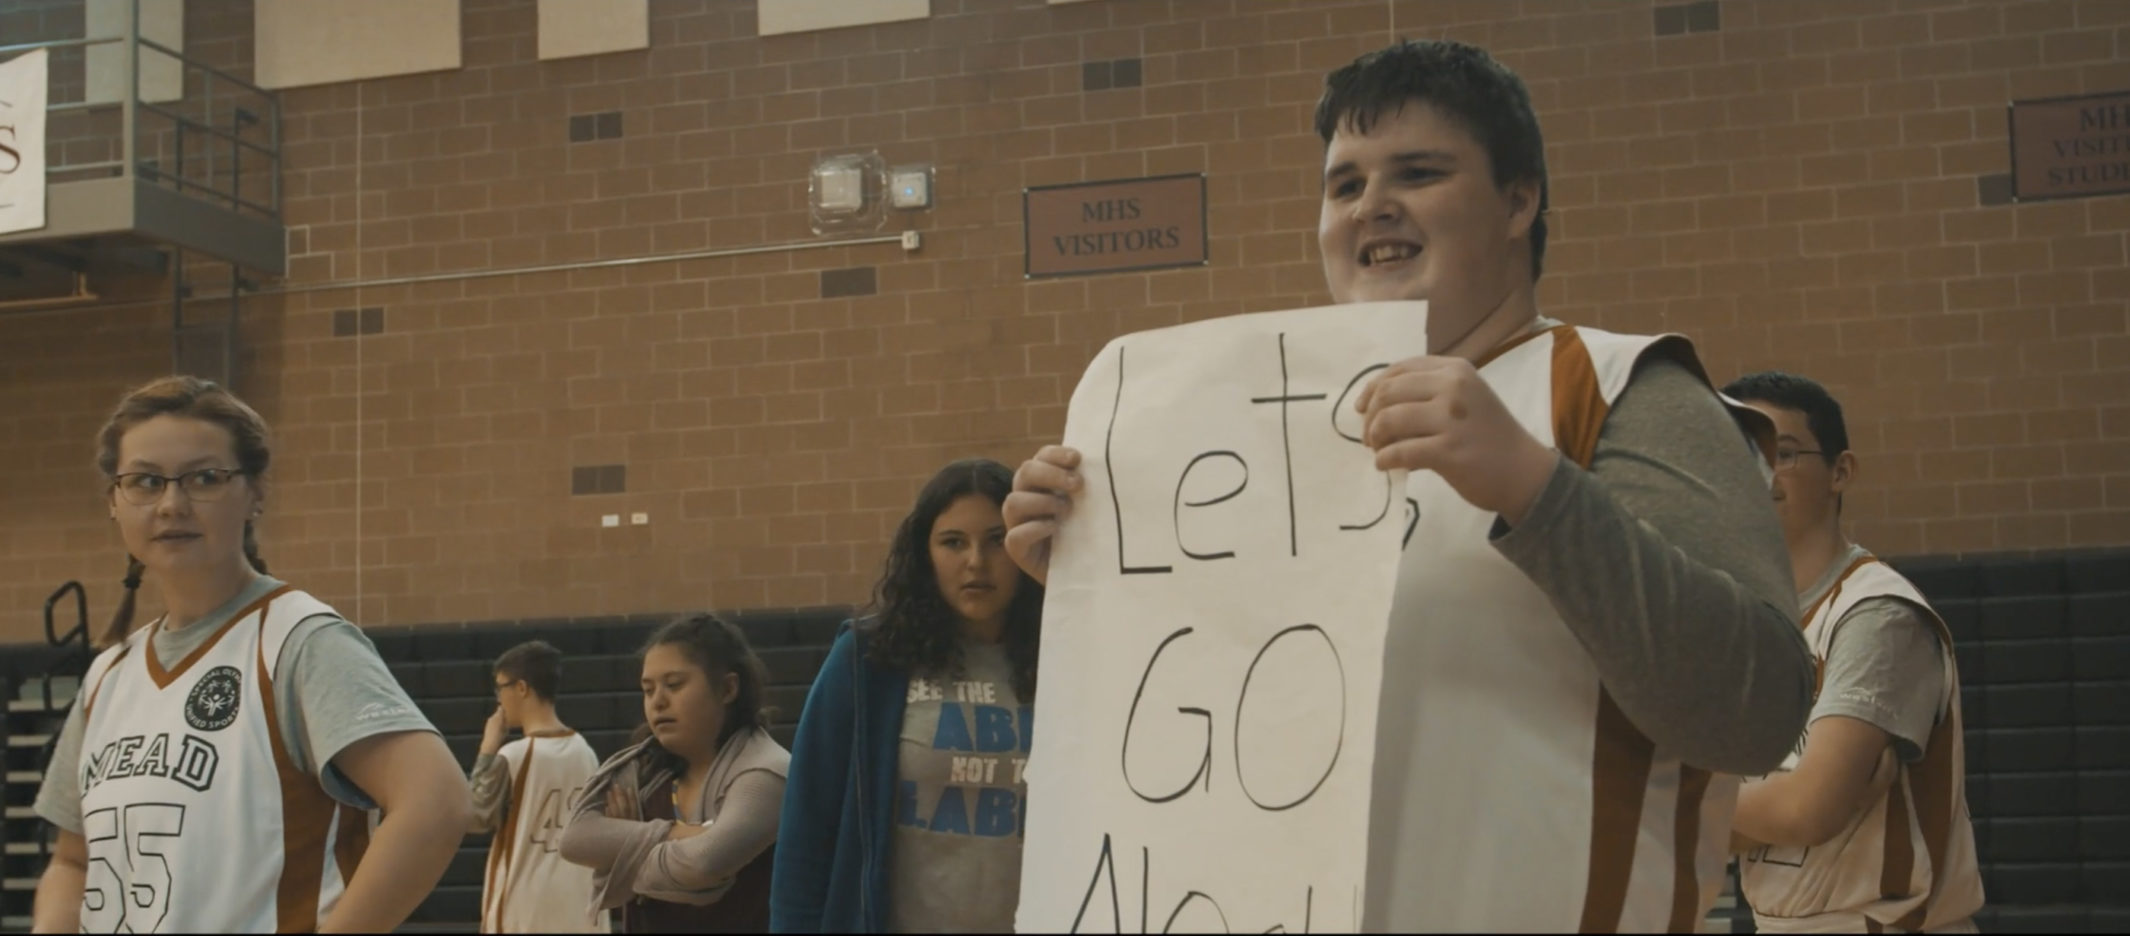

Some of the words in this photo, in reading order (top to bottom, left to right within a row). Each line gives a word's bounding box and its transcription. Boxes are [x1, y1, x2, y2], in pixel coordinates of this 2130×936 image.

[1081, 198, 1141, 223] MHS
[1053, 226, 1181, 256] VISITORS
[906, 680, 943, 704] SEE
[951, 681, 997, 704] THE
[1122, 623, 1346, 812] GO
[80, 733, 219, 793] MEAD
[951, 756, 998, 784] NOT
[81, 803, 186, 934] 55
